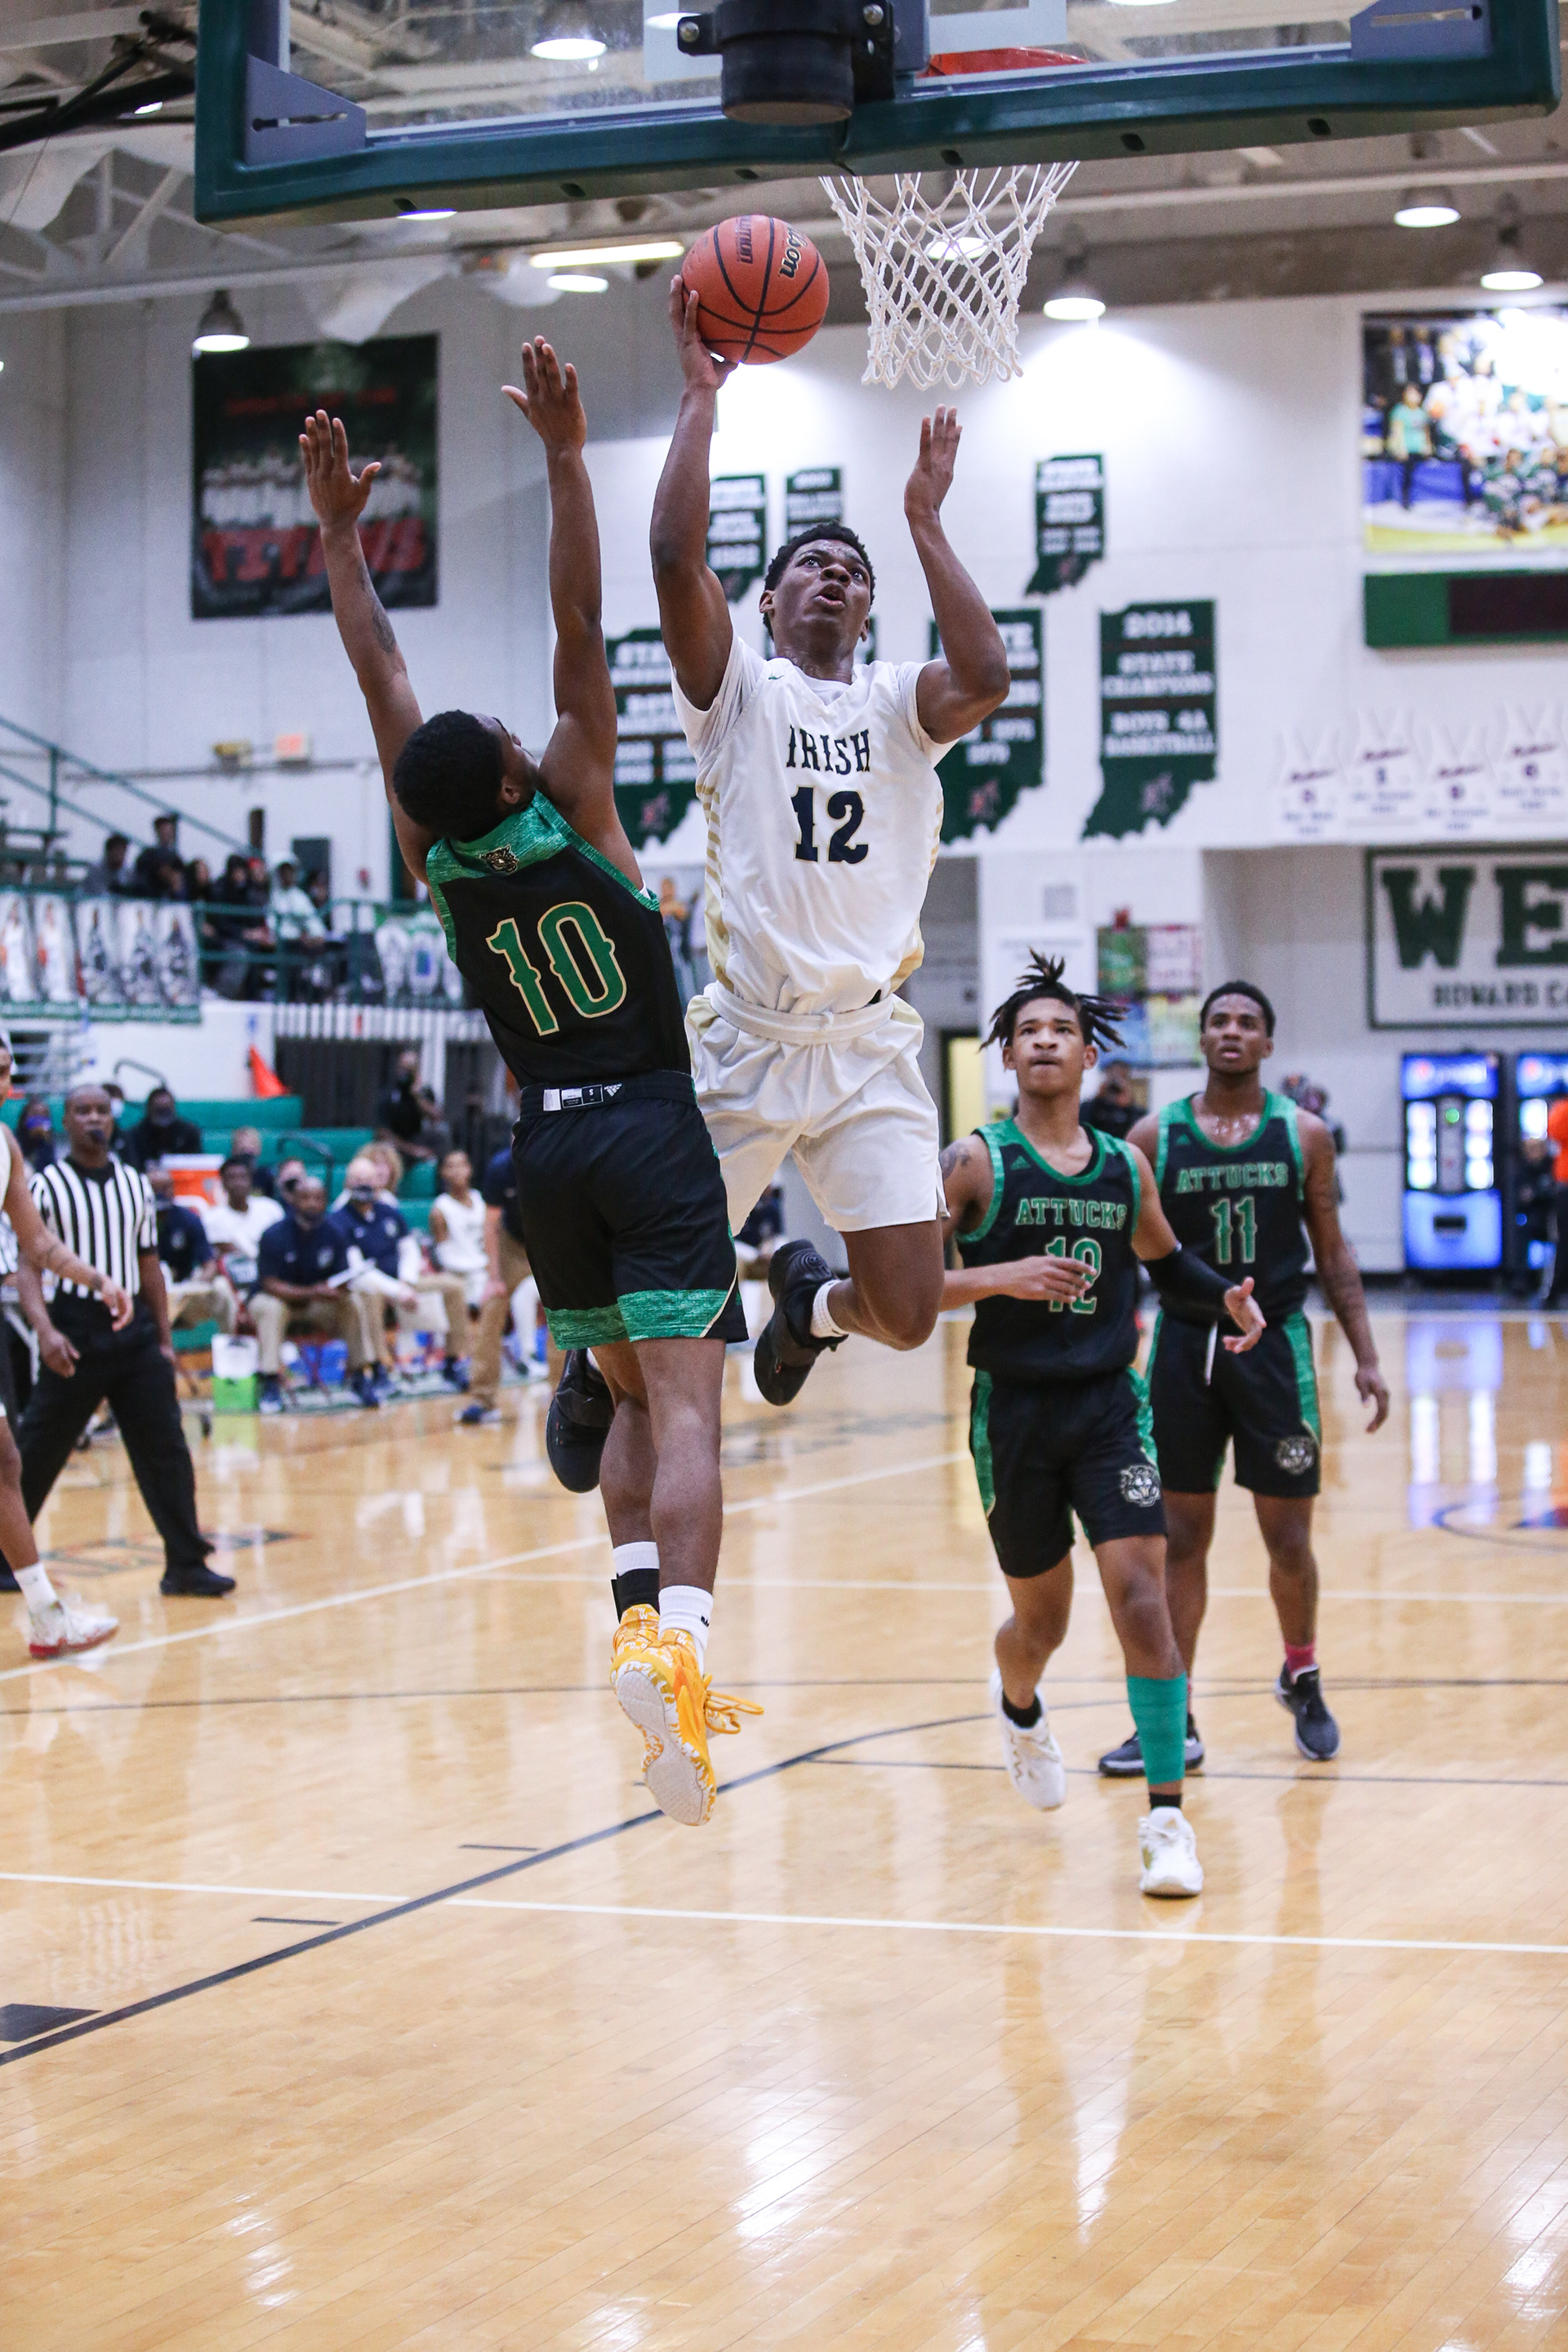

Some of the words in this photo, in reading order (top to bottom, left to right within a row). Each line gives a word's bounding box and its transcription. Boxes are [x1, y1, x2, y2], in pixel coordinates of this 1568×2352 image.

[1123, 611, 1194, 639] 2014
[1117, 650, 1196, 675] STATE
[1102, 672, 1214, 697] CHAMPIONS
[1110, 710, 1170, 734] BOYS
[786, 724, 871, 776] IRISH
[790, 785, 870, 865] 12
[1380, 866, 1568, 970] WE
[485, 901, 627, 1037] 10
[1176, 1161, 1289, 1194] ATTUCKS
[1015, 1197, 1128, 1231] ATTUCKS
[1210, 1196, 1258, 1265] 11
